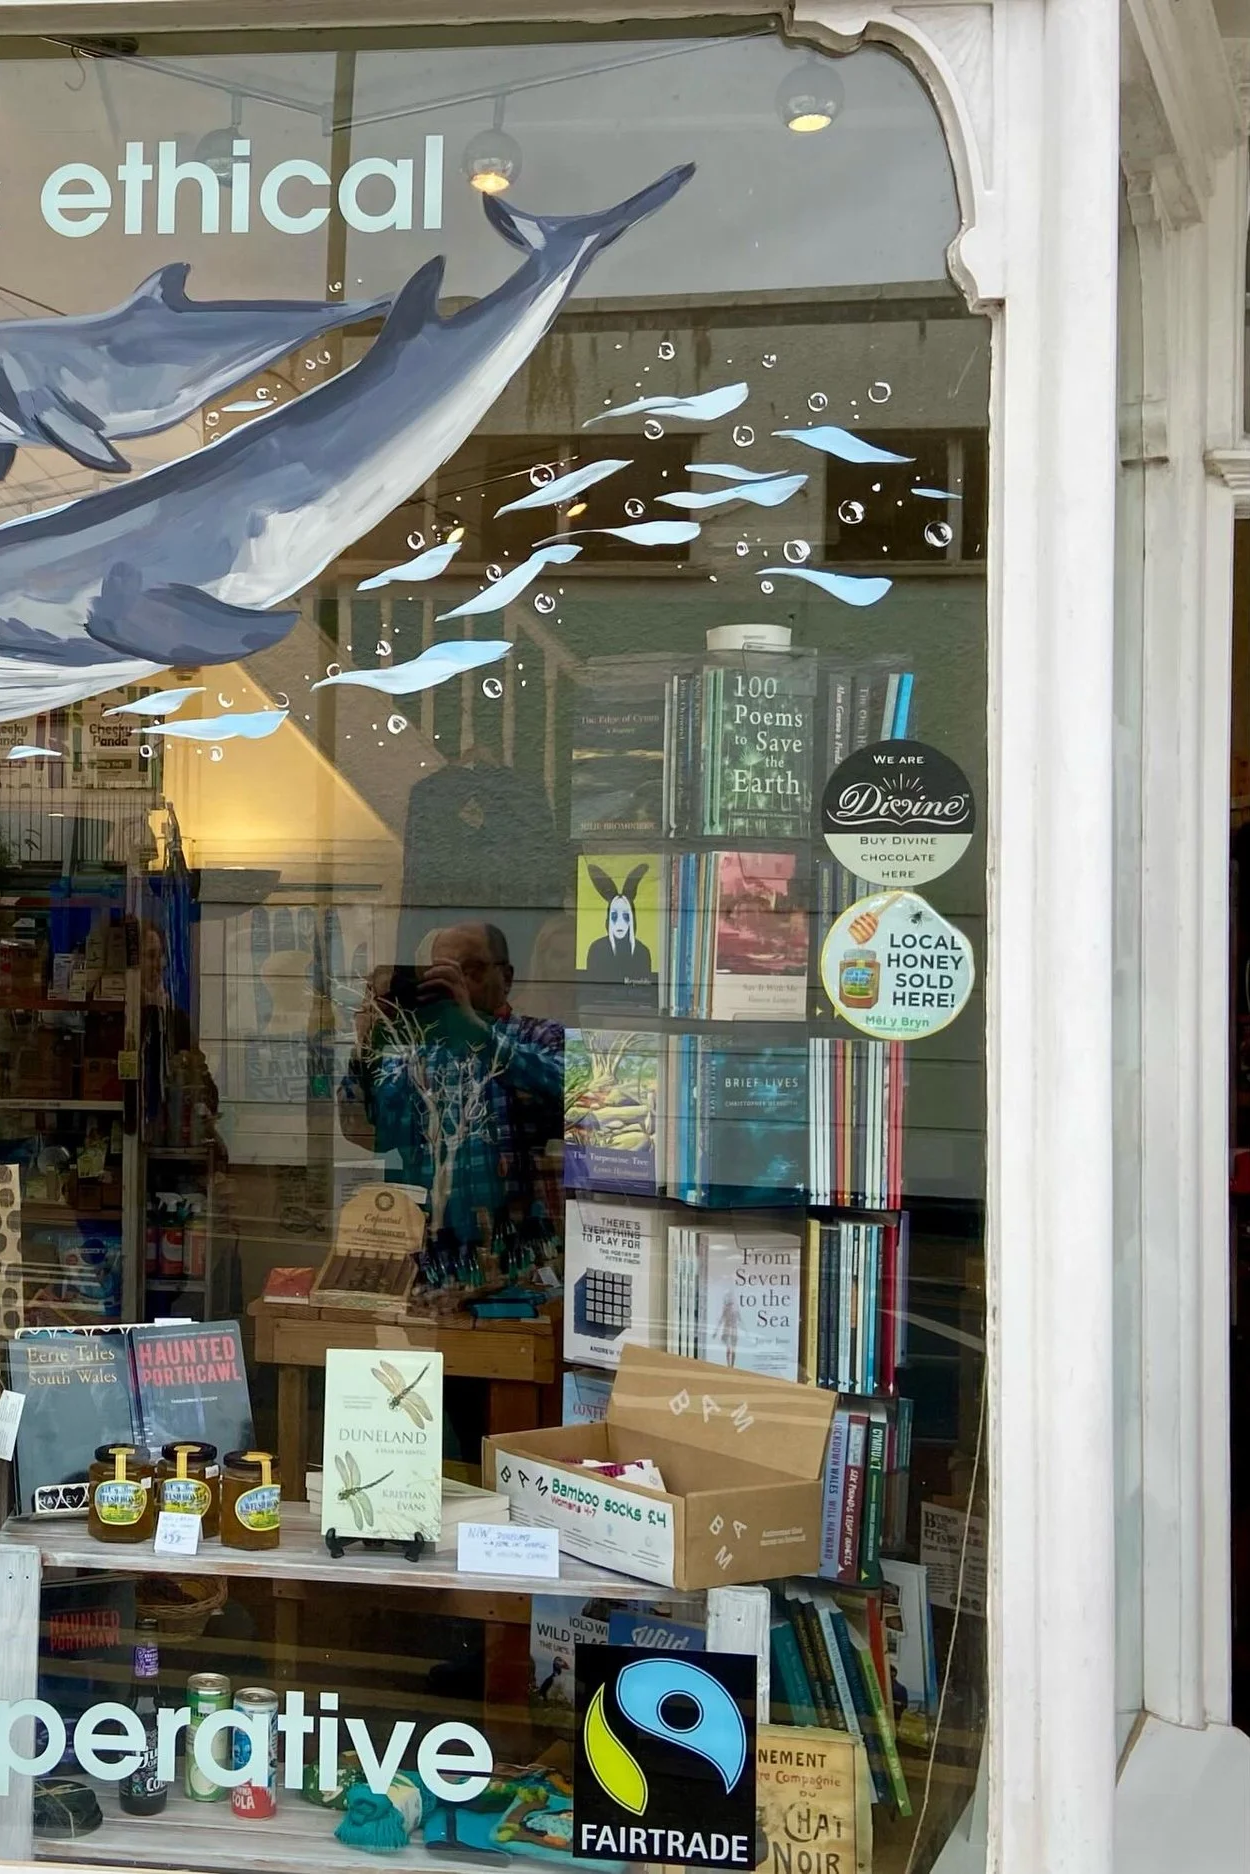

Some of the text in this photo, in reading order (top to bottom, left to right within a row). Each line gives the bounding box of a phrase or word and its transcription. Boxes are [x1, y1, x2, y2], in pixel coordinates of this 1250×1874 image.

[40, 135, 444, 238] ethical
[733, 675, 778, 699] 100
[734, 704, 803, 728] Poems
[89, 723, 133, 737] Cheeky
[93, 735, 128, 747] Panda
[735, 731, 803, 753] to Save
[765, 755, 785, 768] the
[873, 755, 925, 764] WE ARE
[731, 769, 801, 795] Earth
[836, 782, 965, 818] Divine
[860, 836, 937, 845] BUY DIVINE
[861, 854, 936, 862] CHOCOLATE
[882, 870, 916, 879] HERE
[889, 933, 962, 951] LOCAL
[887, 953, 964, 970] HONEY
[895, 973, 953, 989] SOLD
[892, 991, 956, 1009] HERE!
[890, 1017, 898, 1027] y
[901, 1015, 930, 1028] Bryn
[725, 1077, 799, 1088] BRIEF LIVES
[600, 1217, 641, 1231] THERE'S
[582, 1232, 641, 1250] TO PLAY FOR
[742, 1248, 791, 1266] From
[735, 1268, 791, 1286] Seven
[739, 1289, 791, 1307] to the
[756, 1309, 790, 1328] Sea
[75, 1344, 116, 1362] Tales
[139, 1335, 235, 1368] HAUNTED
[28, 1367, 118, 1386] South Wales
[141, 1361, 243, 1388] PORTHCAWL
[339, 1427, 428, 1445] DUNELAND
[830, 1420, 843, 1468] LOCKDOWN
[870, 1428, 883, 1458] CYMRU
[829, 1468, 839, 1495] WALES
[382, 1488, 426, 1501] KRISTIAN
[551, 1478, 667, 1529] Bamboo socks £4
[397, 1503, 426, 1512] EVANS
[550, 1495, 581, 1514] Womens
[536, 1622, 571, 1643] WILD
[775, 1770, 842, 1789] Compagnie
[785, 1801, 845, 1843] CHAT
[580, 1823, 749, 1863] FAIRTRADE
[772, 1840, 841, 1874] NOIR
